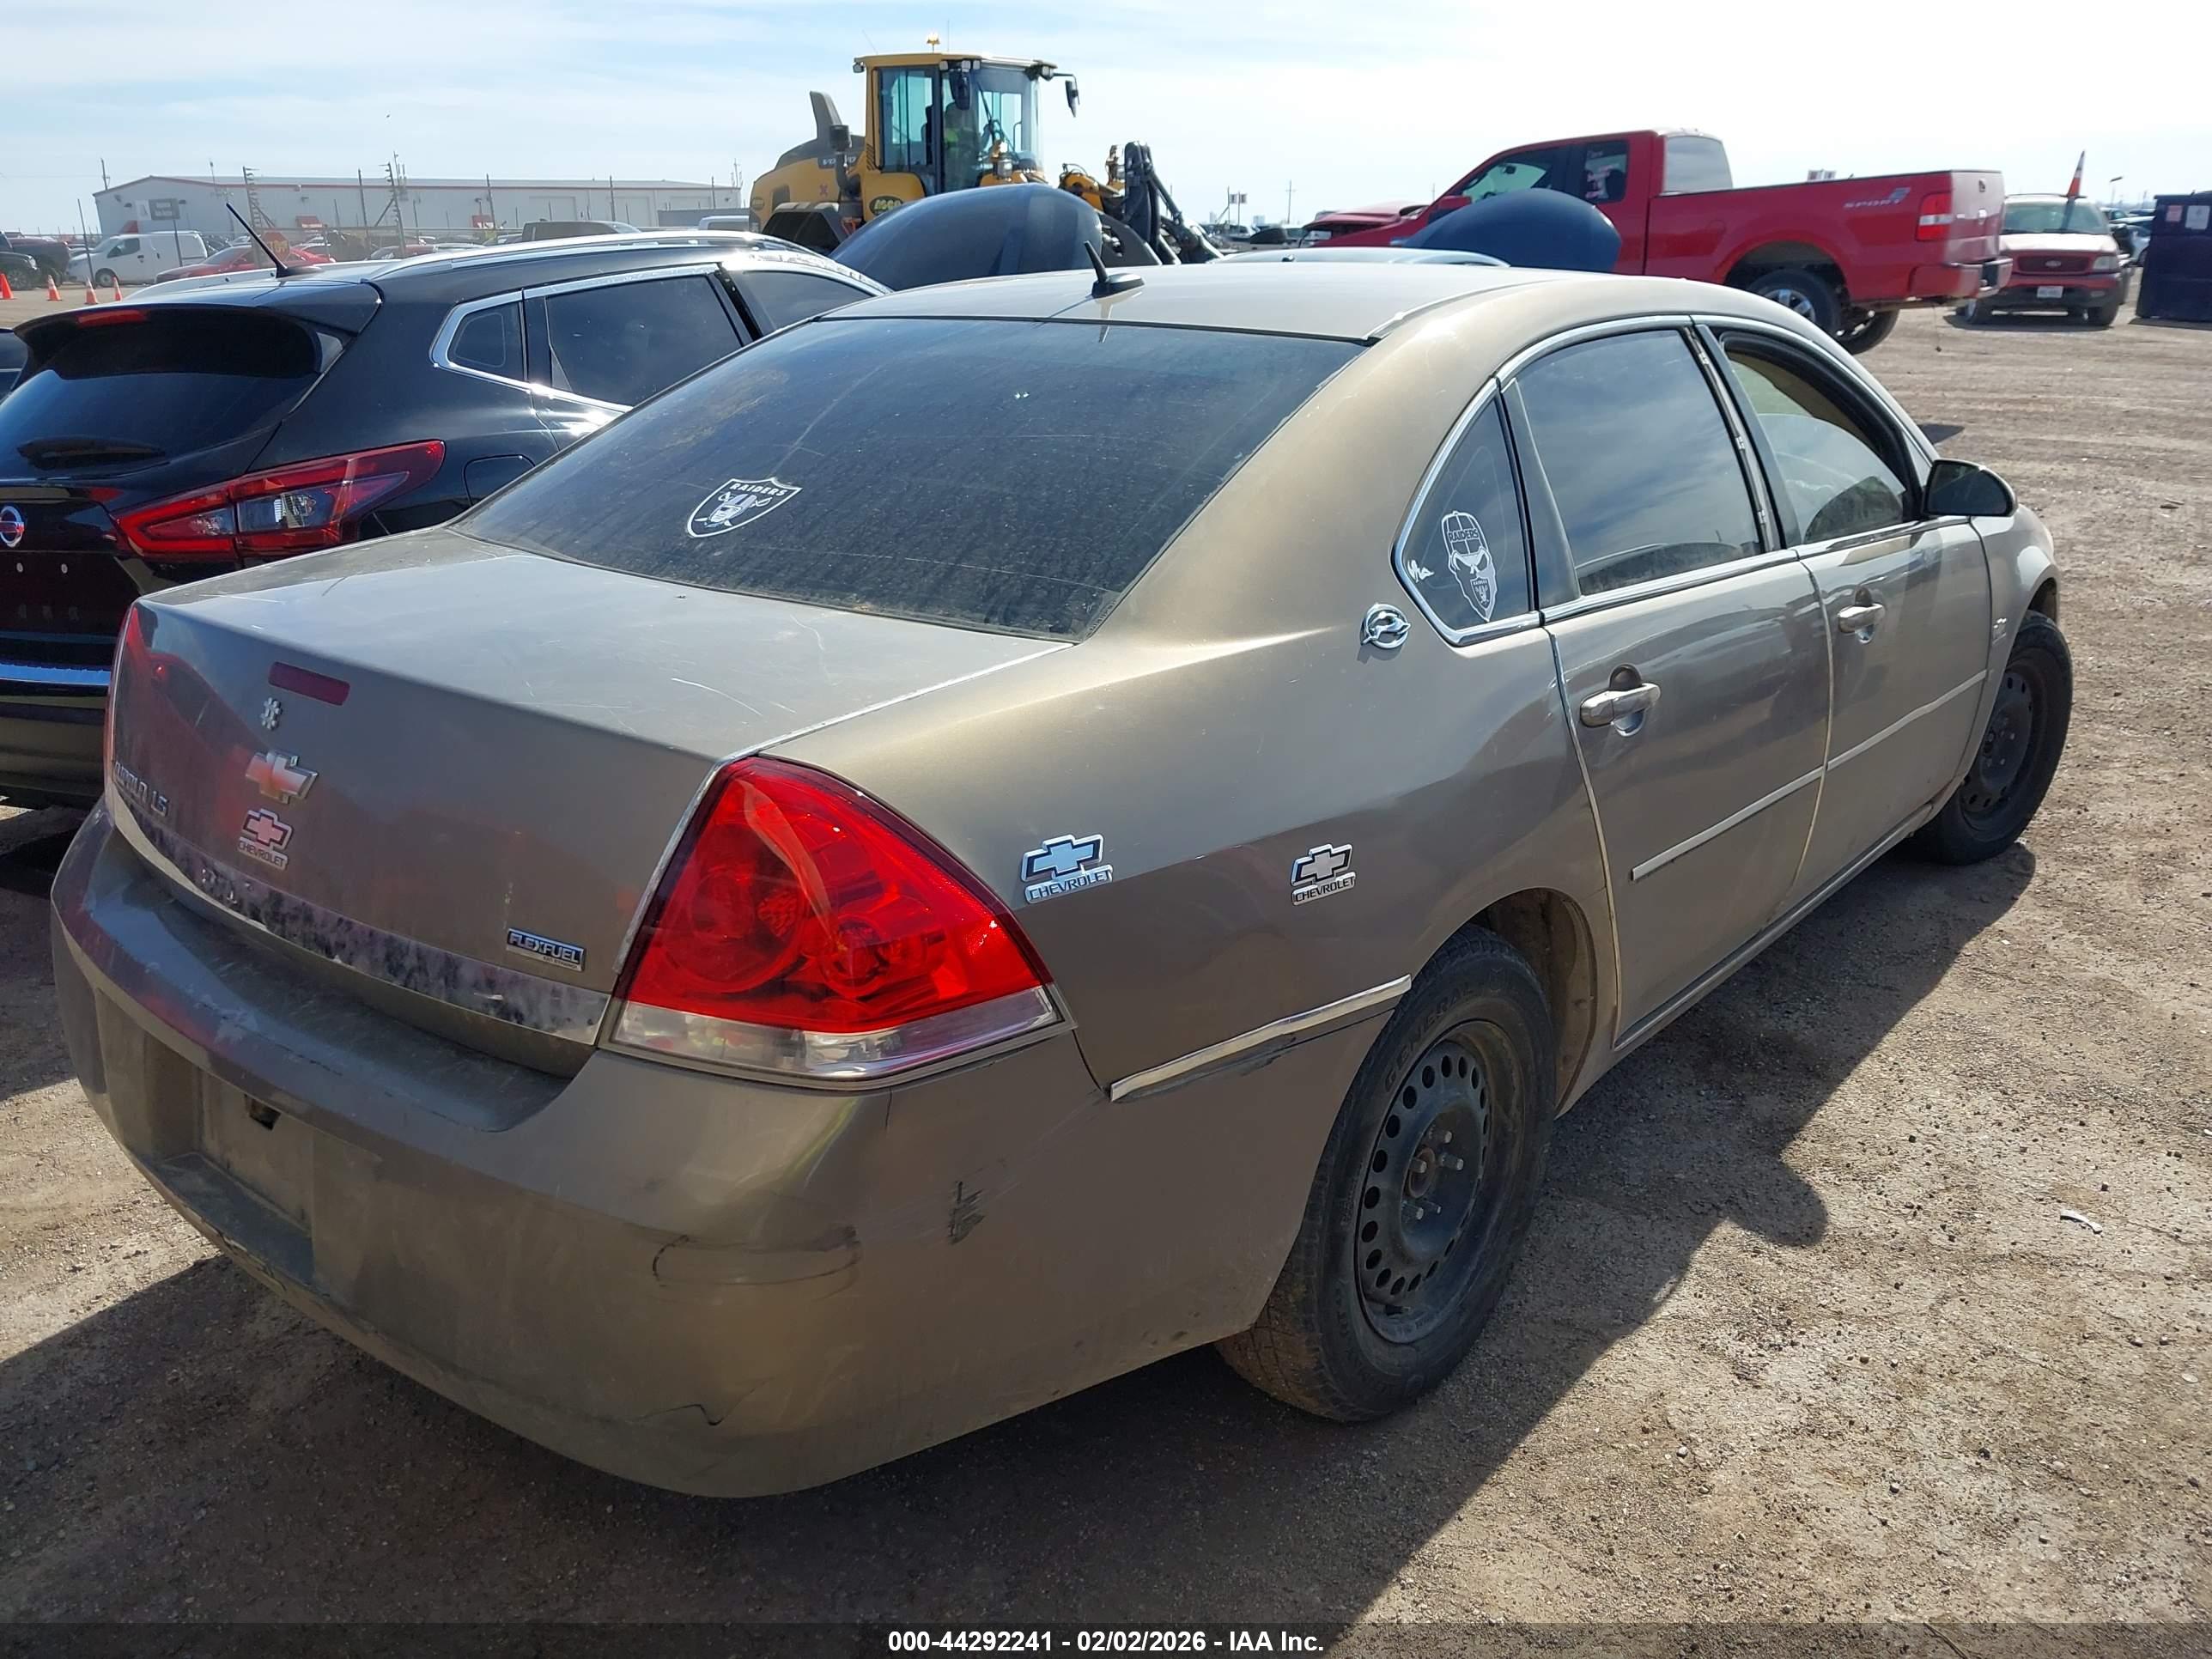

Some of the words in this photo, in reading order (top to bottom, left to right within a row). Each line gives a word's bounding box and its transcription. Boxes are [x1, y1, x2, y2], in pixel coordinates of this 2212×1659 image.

[729, 483, 788, 496] RAIDERS
[1448, 528, 1479, 542] RAIDERS
[150, 790, 168, 817] LS
[239, 841, 284, 868] CHEVROLET
[1030, 870, 1109, 901] CHEVROLET
[1295, 875, 1355, 902] CHEVROLET
[508, 932, 580, 963] FLEXFUEL
